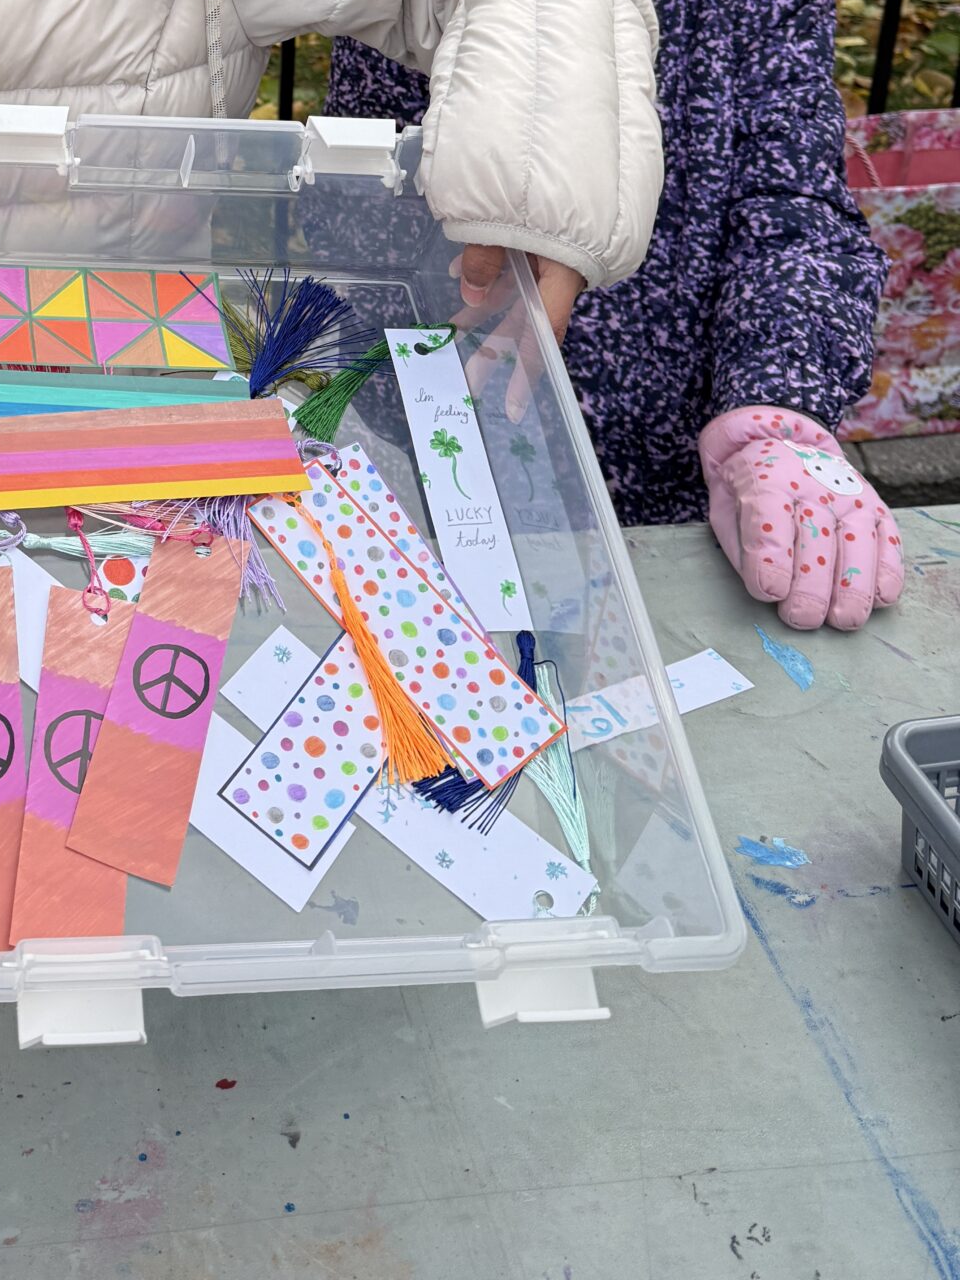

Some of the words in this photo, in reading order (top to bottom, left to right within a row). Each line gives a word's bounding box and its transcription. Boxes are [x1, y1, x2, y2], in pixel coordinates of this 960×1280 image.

[415, 388, 435, 403] I'm
[434, 405, 470, 424] feeling
[445, 506, 493, 523] LUCKY
[456, 528, 497, 550] today
